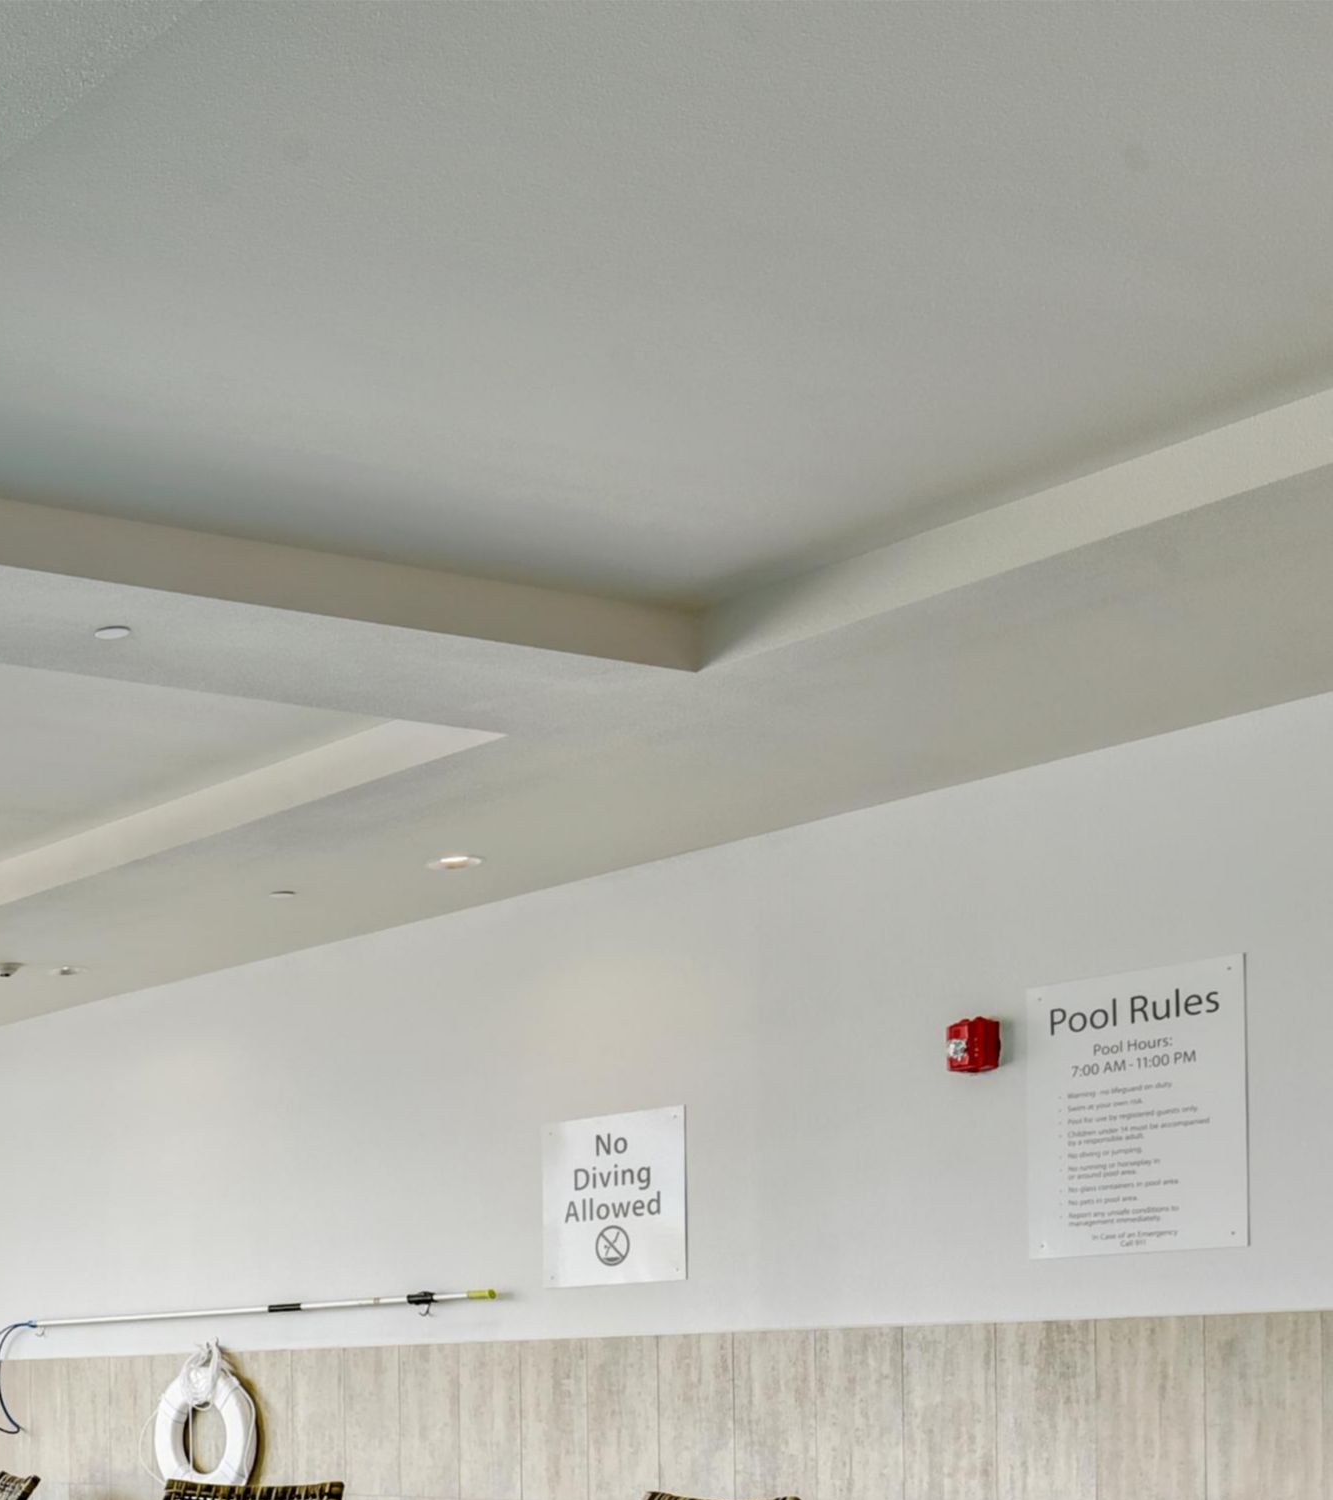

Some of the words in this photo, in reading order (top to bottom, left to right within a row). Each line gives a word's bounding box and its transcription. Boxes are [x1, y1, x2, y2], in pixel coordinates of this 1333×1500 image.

[1050, 998, 1117, 1036] Pool
[1130, 988, 1220, 1024] Rules
[1093, 1040, 1123, 1056] Pool
[1127, 1036, 1173, 1052] Hours:
[1071, 1063, 1099, 1078] 7:00
[1103, 1059, 1126, 1074] AM
[1136, 1053, 1170, 1069] 11:00
[1174, 1050, 1196, 1064] PM
[595, 1132, 628, 1157] No
[573, 1164, 651, 1191] Diving
[564, 1190, 661, 1223] Allowed
